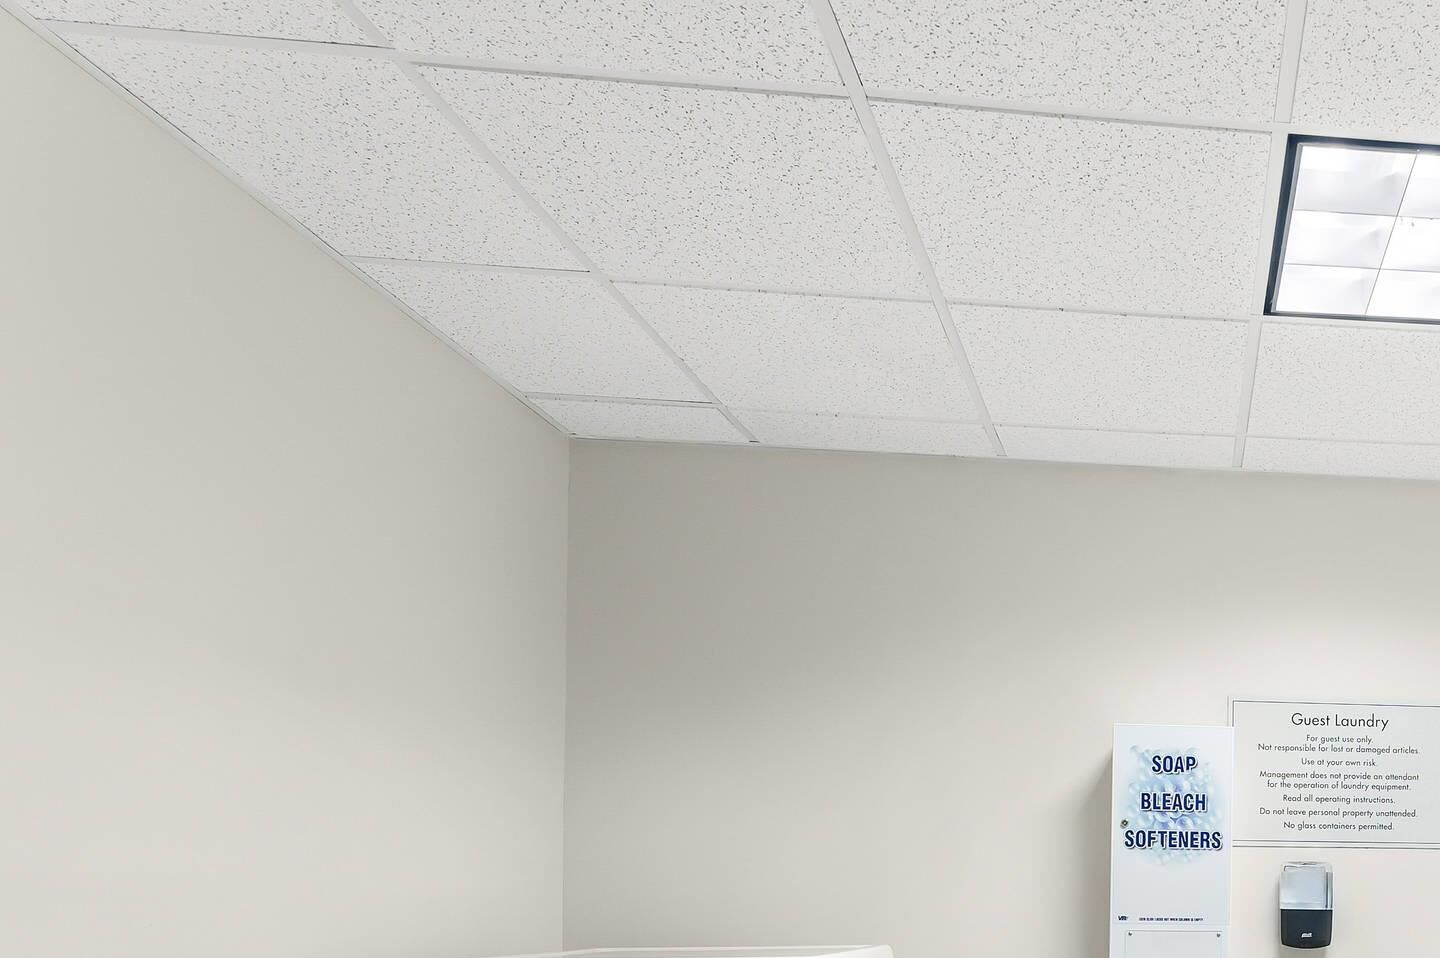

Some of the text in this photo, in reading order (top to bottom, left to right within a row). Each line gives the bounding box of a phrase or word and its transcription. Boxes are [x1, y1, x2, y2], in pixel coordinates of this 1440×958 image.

[1291, 712, 1389, 732] Guest Laundry
[1306, 734, 1318, 742] For
[1320, 735, 1341, 744] guest
[1257, 743, 1272, 751] Not
[1274, 743, 1316, 752] responsible
[1318, 743, 1328, 752] for
[1331, 744, 1344, 753] lost
[1356, 745, 1391, 755] damaged
[1151, 755, 1198, 774] SOAP
[1301, 757, 1315, 765] Use
[1259, 770, 1308, 780] Management
[1310, 771, 1328, 779] does
[1343, 772, 1371, 781] provide
[1385, 772, 1419, 781] attendant
[1267, 779, 1277, 788] for
[1280, 780, 1291, 788] the
[1293, 781, 1329, 790] operation
[1331, 780, 1339, 789] of
[1341, 781, 1369, 792] laundry
[1140, 792, 1208, 812] BLEACH
[1283, 793, 1396, 805] Read all operating instructions.
[1259, 807, 1270, 815] Do
[1286, 807, 1306, 815] leave
[1308, 808, 1340, 817] personal
[1342, 810, 1373, 818] property
[1375, 809, 1418, 818] unattended.
[1283, 821, 1295, 829] No
[1297, 820, 1316, 831] glass
[1318, 822, 1356, 830] containers
[1124, 830, 1223, 850] SOFTENERS
